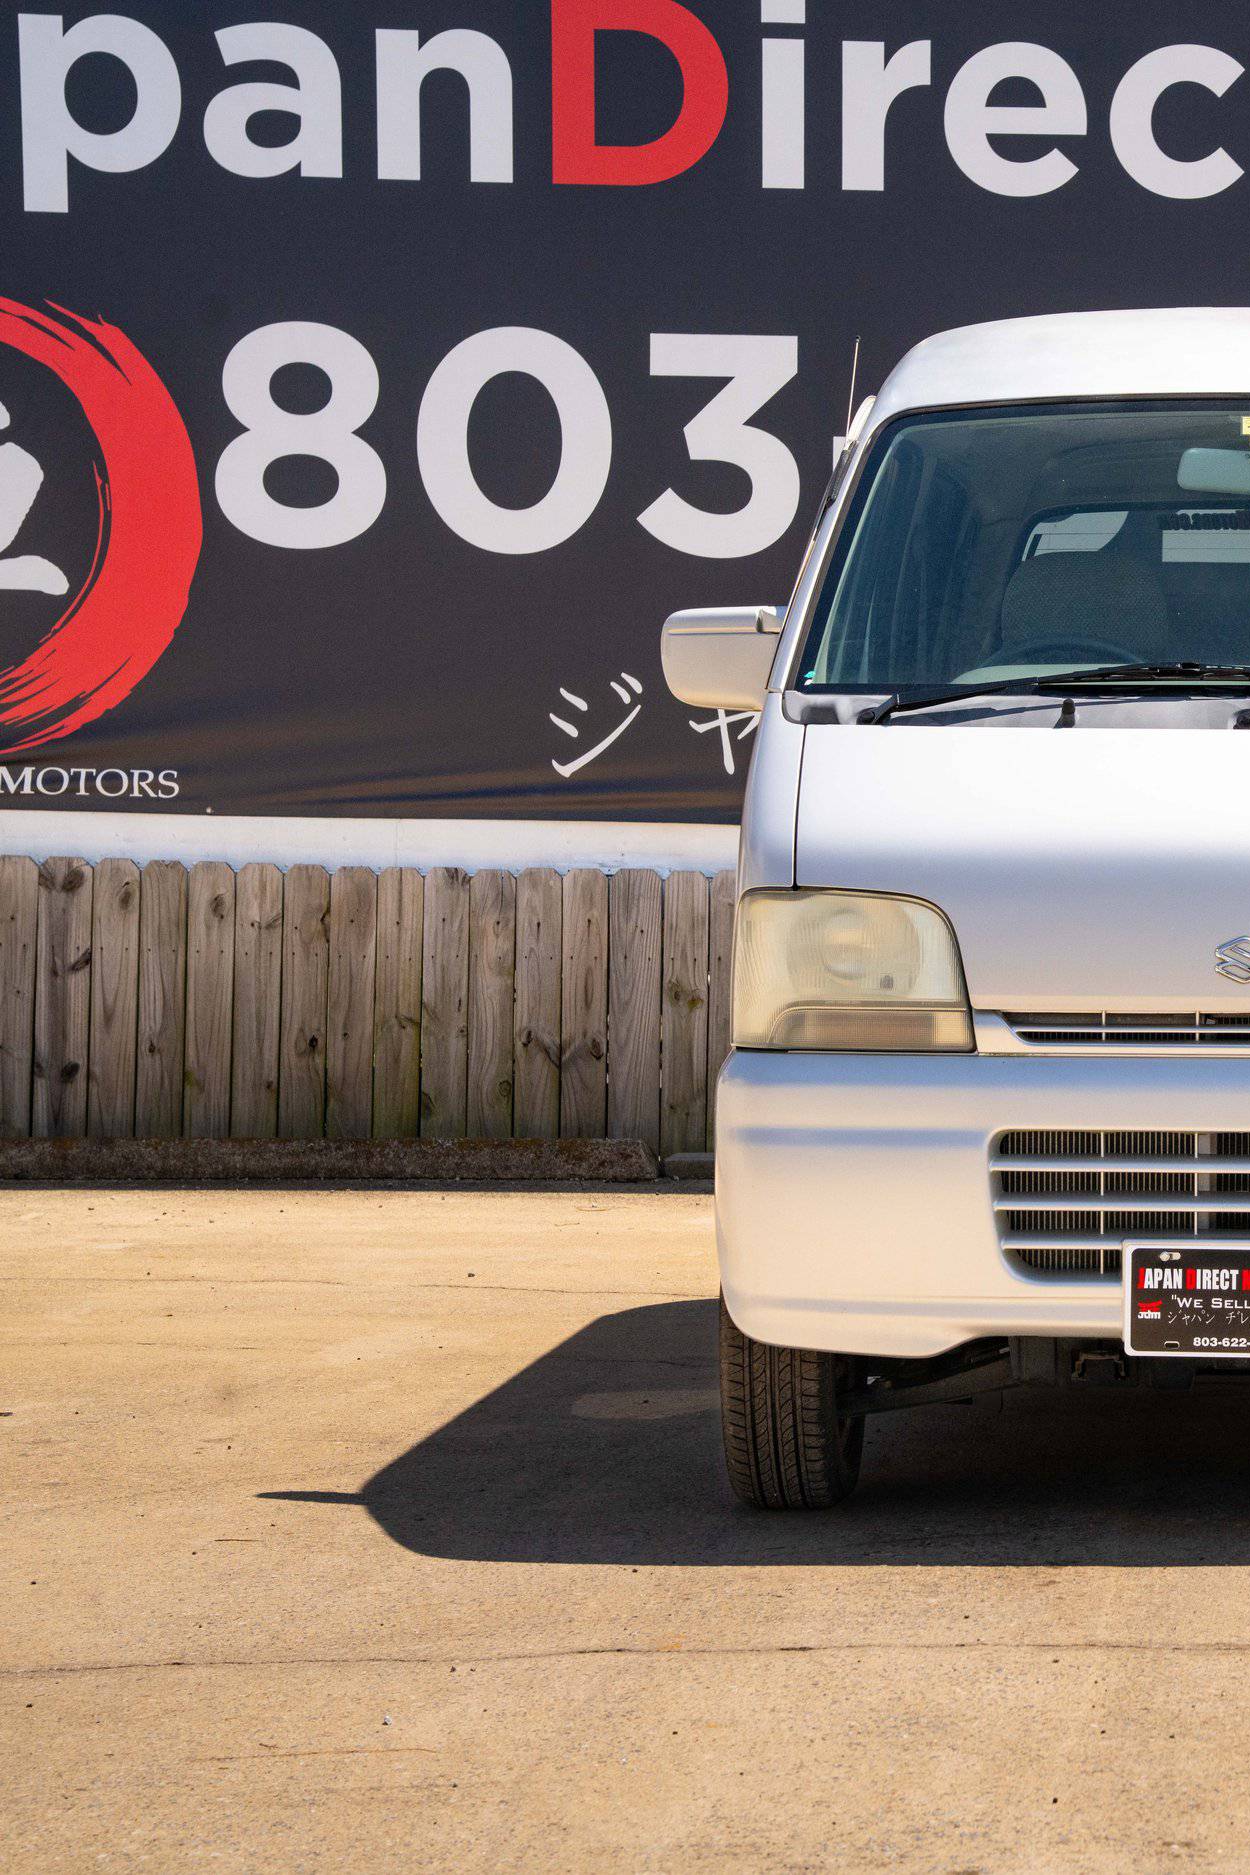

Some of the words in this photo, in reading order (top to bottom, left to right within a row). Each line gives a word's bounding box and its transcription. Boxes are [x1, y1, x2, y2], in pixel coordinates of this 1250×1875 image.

[0, 766, 180, 798] MOTORS
[1137, 1267, 1183, 1289] JAPAN
[1186, 1268, 1239, 1290] DIRECT
